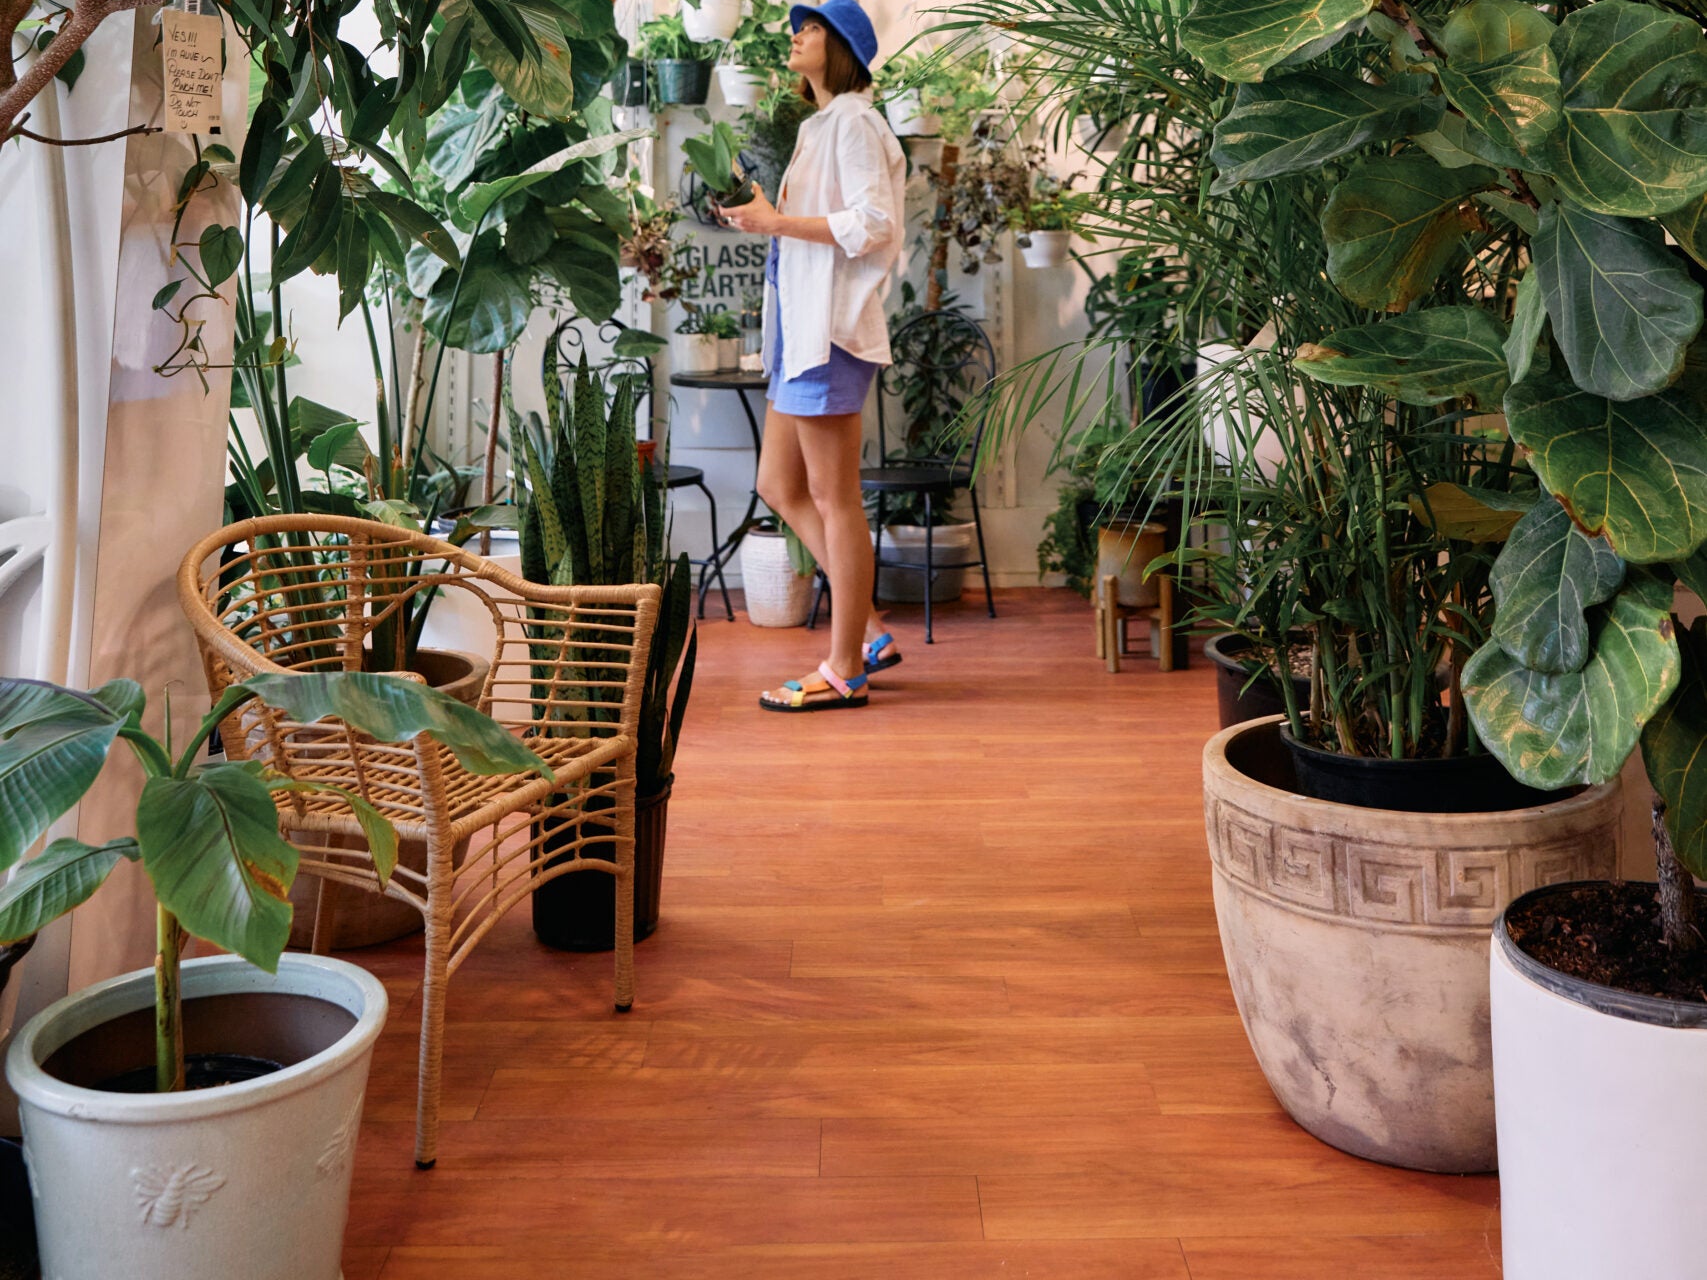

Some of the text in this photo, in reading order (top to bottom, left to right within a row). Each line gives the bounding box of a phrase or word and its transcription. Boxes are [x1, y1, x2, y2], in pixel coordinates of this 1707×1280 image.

[180, 50, 199, 60] ALIVE
[167, 58, 196, 79] PLEASE
[686, 244, 765, 268] GLASS
[687, 273, 765, 299] EARTH
